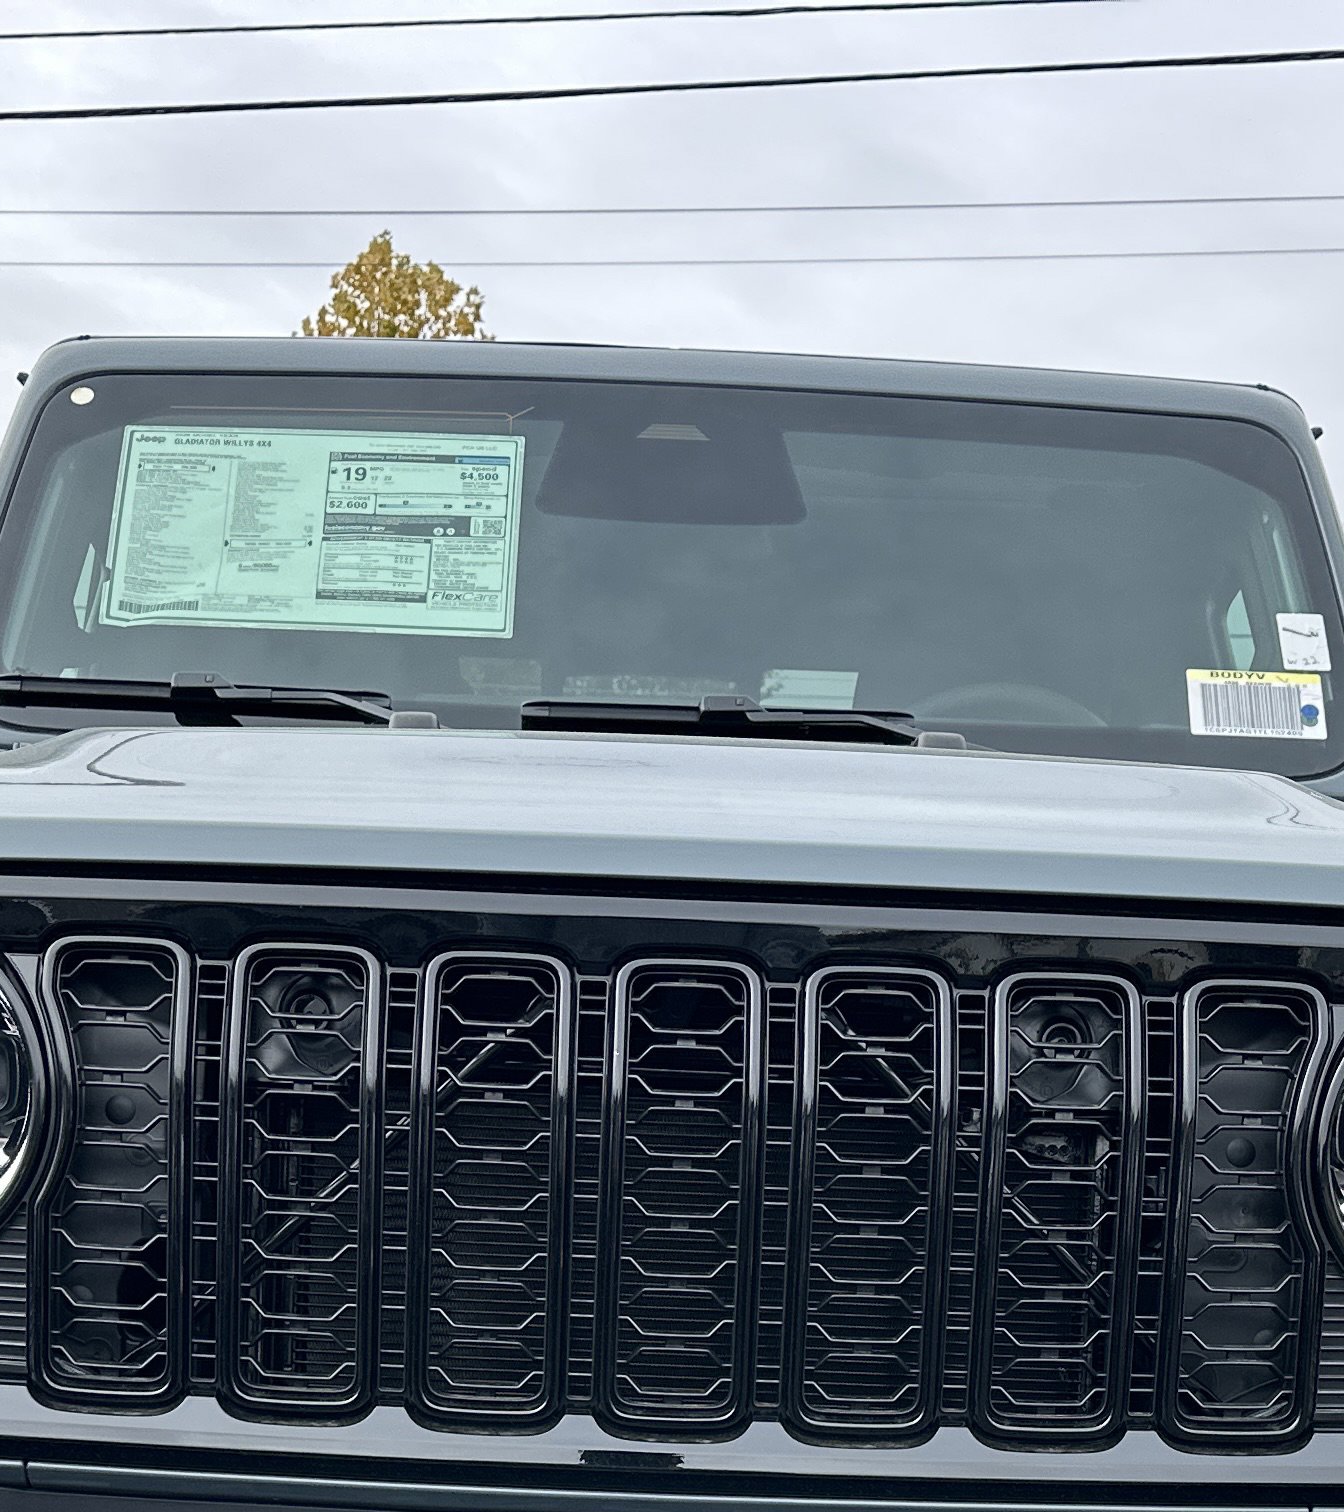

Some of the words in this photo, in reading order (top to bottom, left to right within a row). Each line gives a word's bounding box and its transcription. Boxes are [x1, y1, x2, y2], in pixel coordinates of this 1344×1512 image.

[136, 434, 167, 444] Jeep
[174, 438, 221, 446] GLADIATOR
[223, 439, 254, 447] WILLYS
[256, 440, 272, 448] 4X4
[342, 466, 367, 482] 19
[460, 472, 499, 481] $4,500
[328, 500, 368, 509] $2,600
[431, 590, 499, 602] FlexCare
